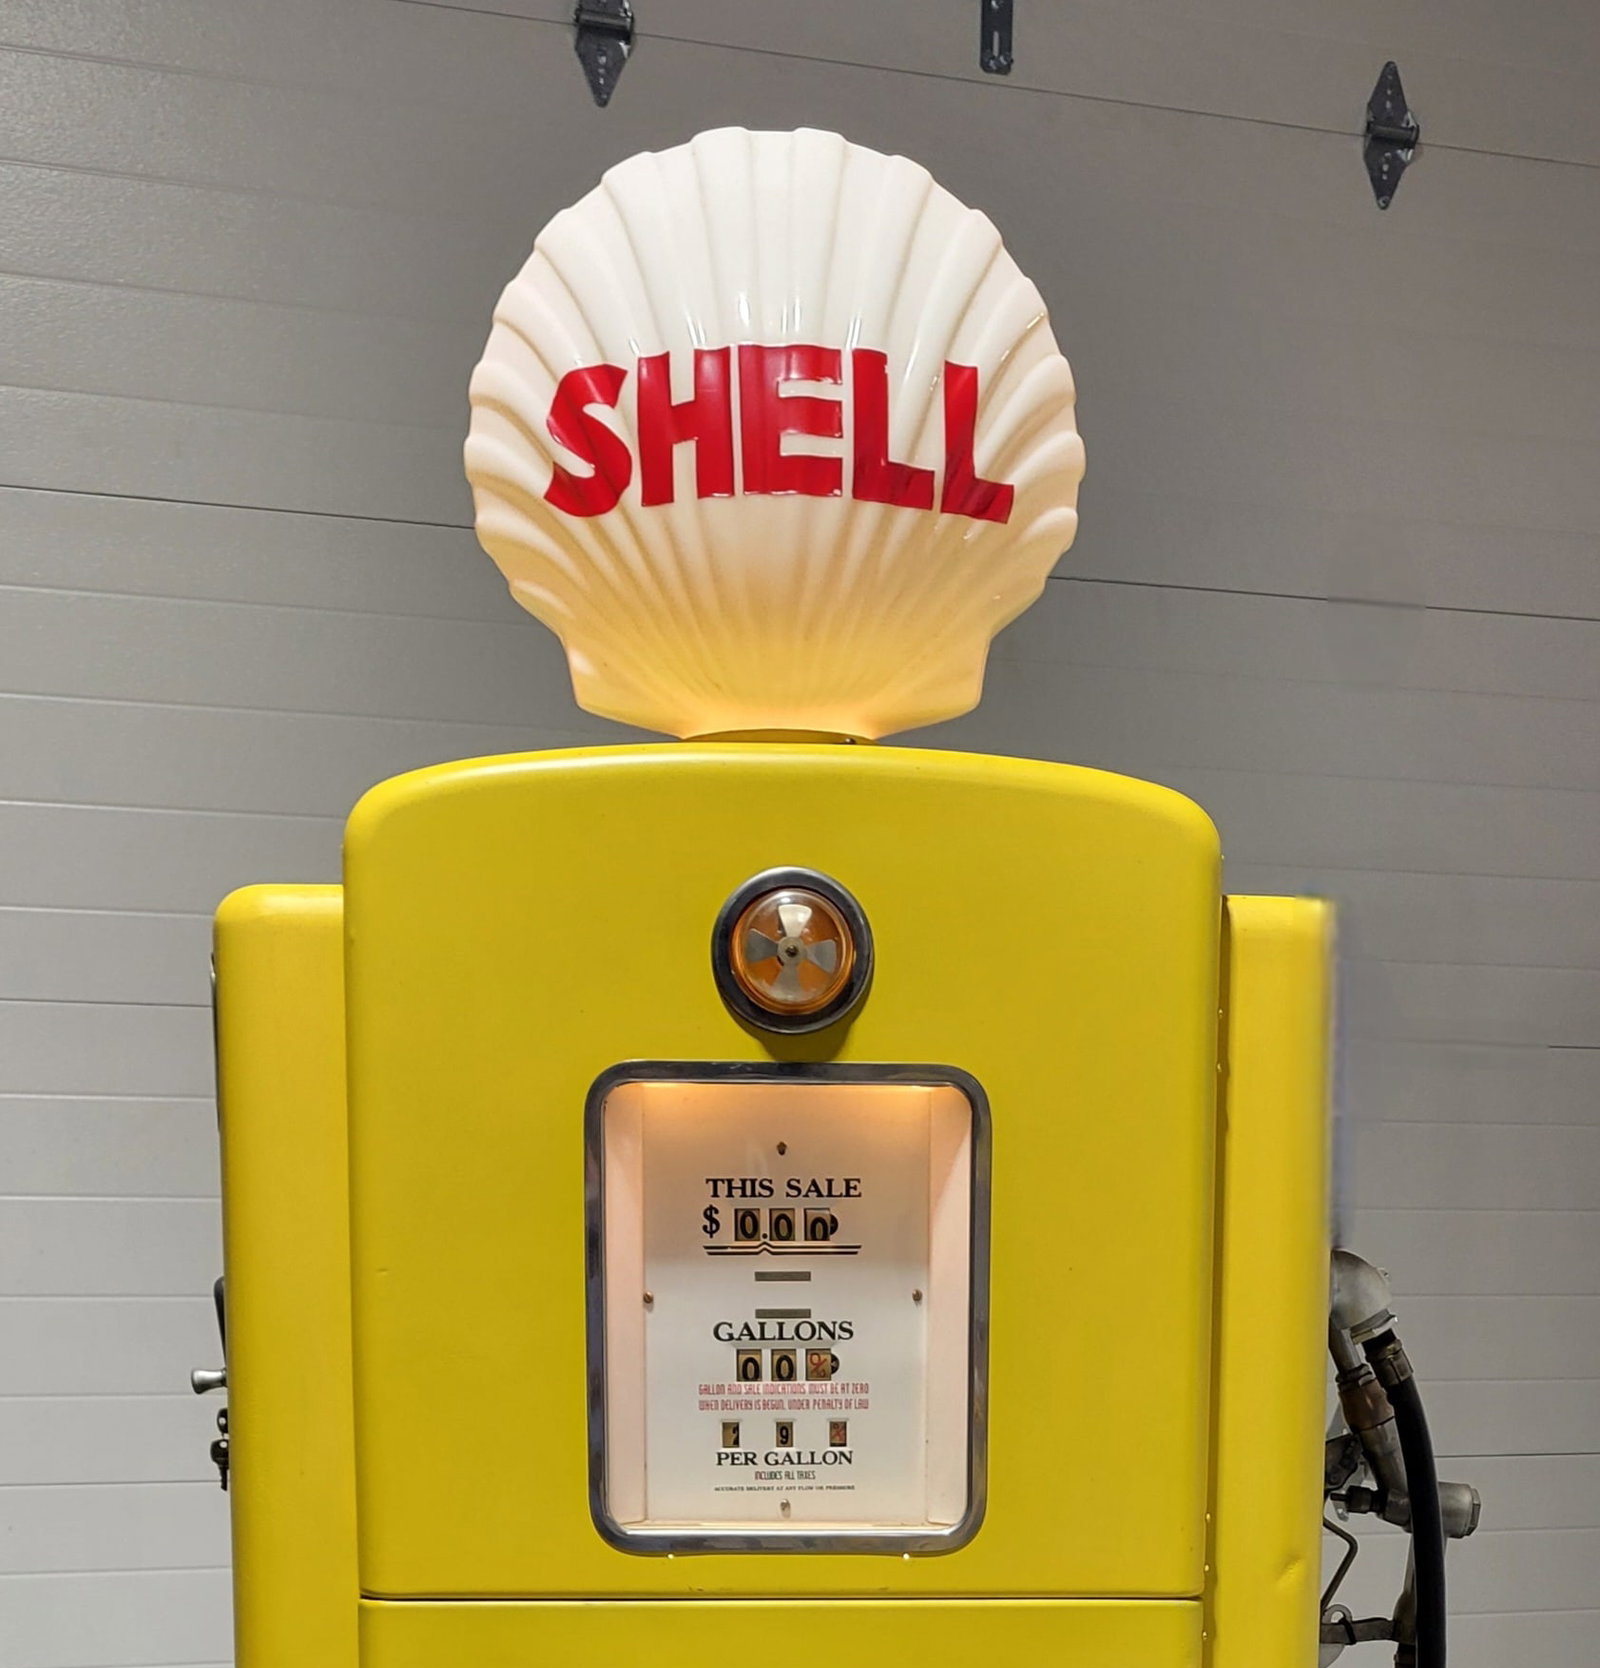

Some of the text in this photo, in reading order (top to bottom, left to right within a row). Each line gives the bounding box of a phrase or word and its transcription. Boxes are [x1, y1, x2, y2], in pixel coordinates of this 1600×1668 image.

[543, 344, 1015, 524] SHELL
[705, 1178, 862, 1198] THIS SALE
[702, 1204, 720, 1239] $
[713, 1320, 854, 1342] GALLONS
[716, 1450, 854, 1466] PER GALLON
